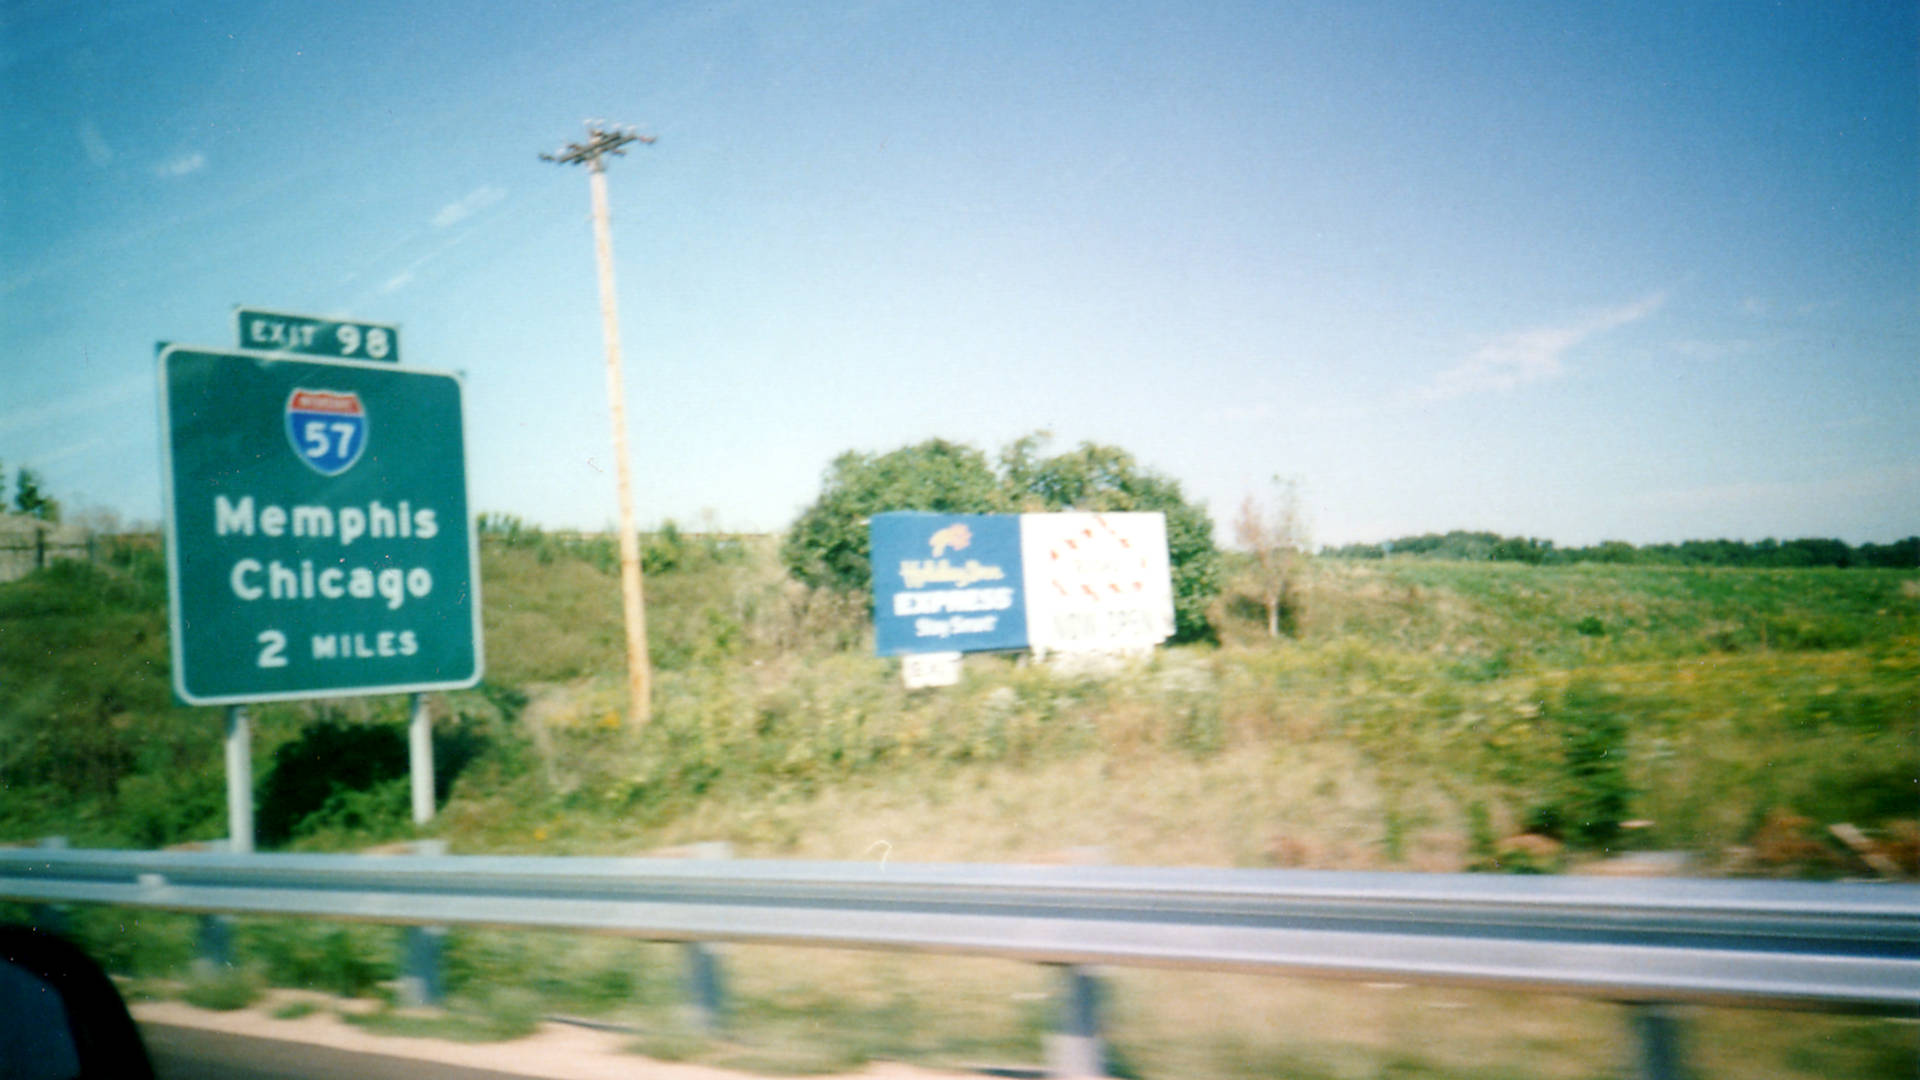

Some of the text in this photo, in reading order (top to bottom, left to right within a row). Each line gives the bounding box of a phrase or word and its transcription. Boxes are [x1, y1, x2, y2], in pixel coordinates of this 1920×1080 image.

[251, 318, 390, 359] EXIT 98
[304, 421, 356, 459] 57
[214, 495, 438, 545] Memphis
[229, 557, 432, 610] Chicago
[256, 629, 418, 668] 2 MILES
